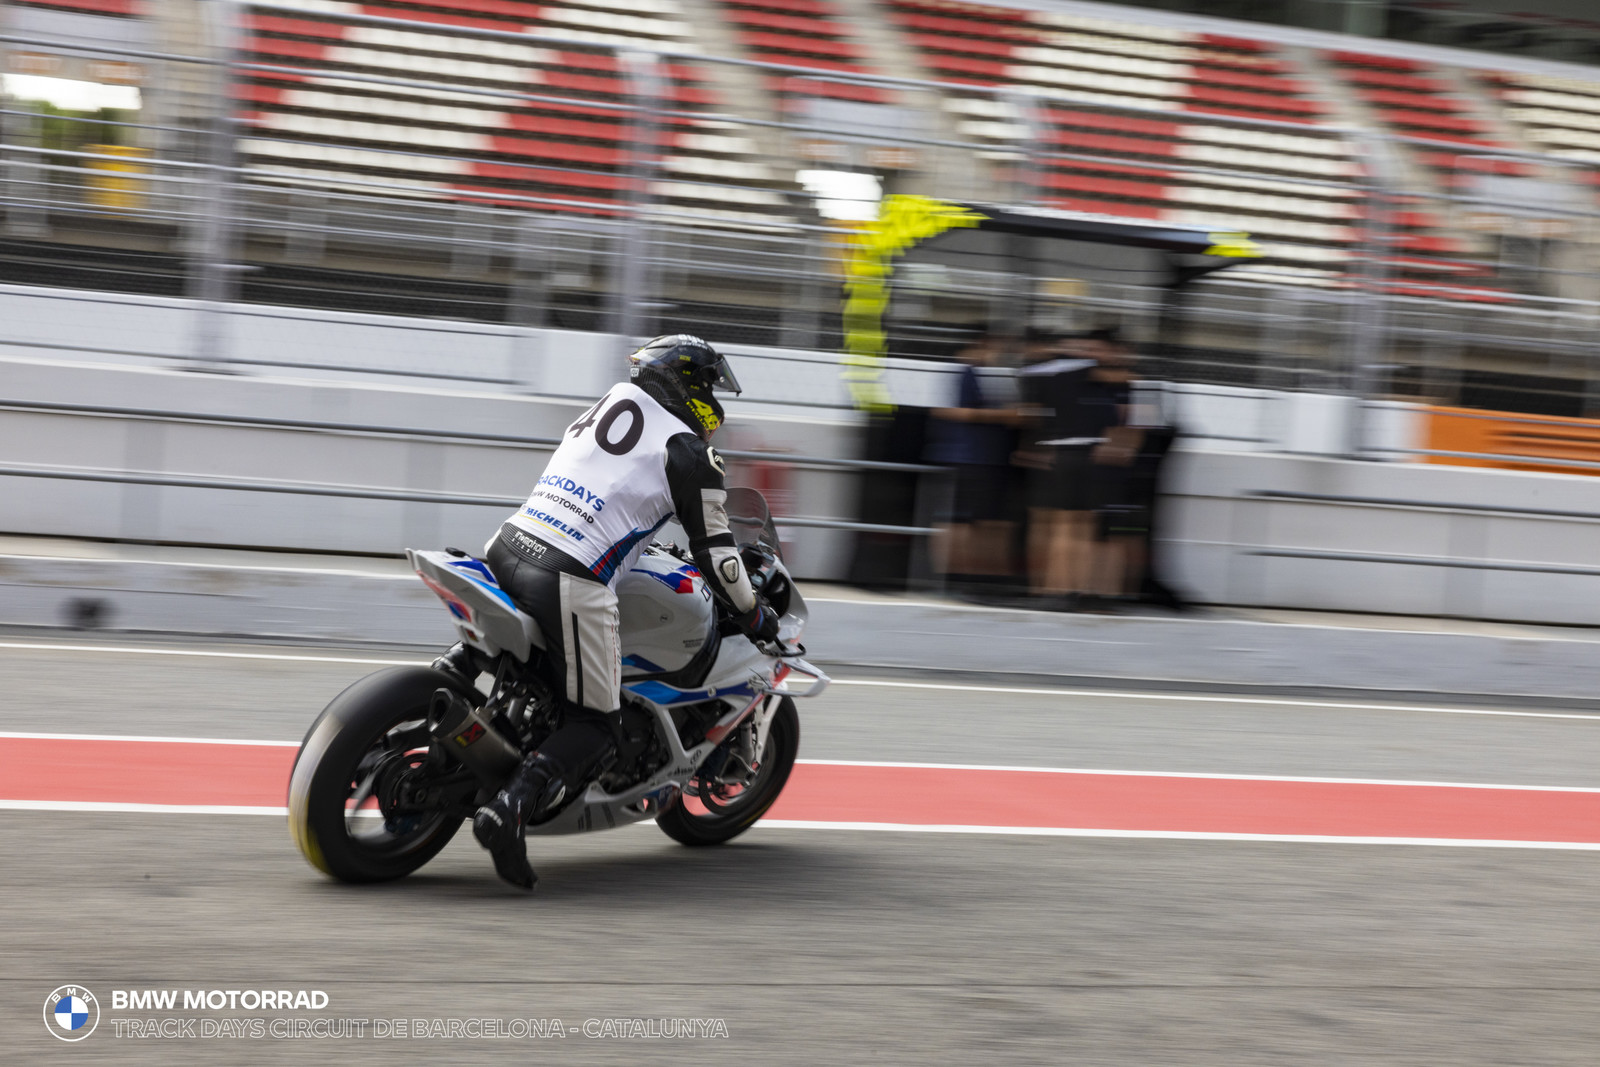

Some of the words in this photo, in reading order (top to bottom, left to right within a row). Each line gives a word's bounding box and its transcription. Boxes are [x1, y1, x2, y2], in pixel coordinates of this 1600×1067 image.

[568, 393, 645, 456] 40
[537, 475, 606, 512] ACKDAYS
[545, 492, 595, 525] MOTORRAD
[525, 507, 585, 542] MICHELIN
